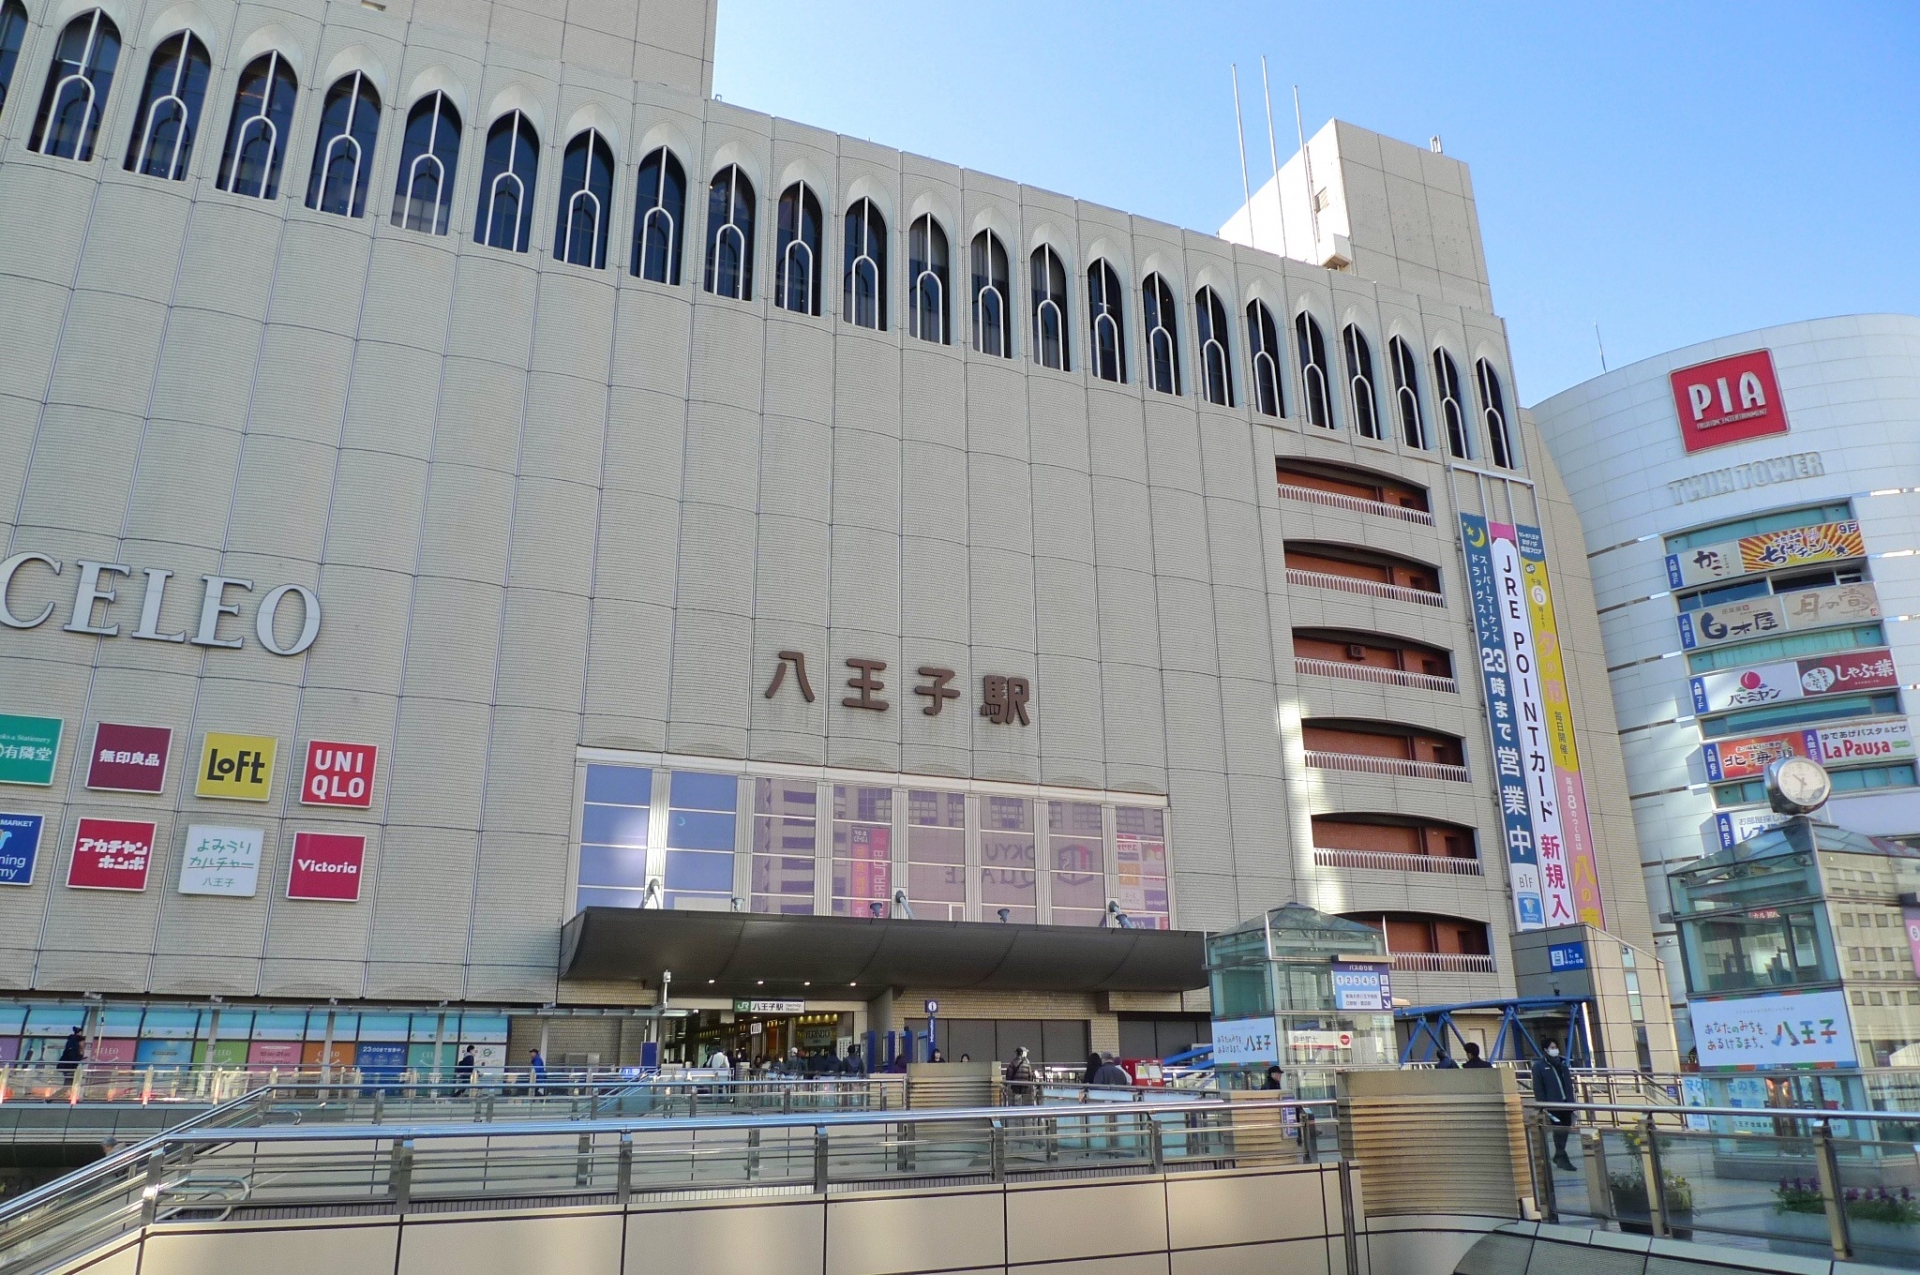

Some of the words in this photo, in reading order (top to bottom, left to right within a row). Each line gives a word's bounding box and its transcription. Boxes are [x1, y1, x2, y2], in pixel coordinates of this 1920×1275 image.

[1687, 370, 1766, 421] PIA
[1667, 467, 1735, 506] TWIN
[1736, 451, 1825, 490] TOWER
[1838, 522, 1858, 535] 9F
[0, 550, 322, 657] CELEO
[1471, 553, 1490, 641] ドラッグストア
[1480, 554, 1500, 643] スーパーマーケット
[1700, 612, 1779, 639] 白木屋
[1835, 659, 1894, 682] しゃぶ葉
[765, 650, 1030, 726] 八王子駅
[1728, 689, 1782, 707] バーミヤン
[1503, 554, 1520, 620] JRE
[1540, 833, 1570, 927] 新規入
[1822, 741, 1842, 759] La
[1843, 738, 1891, 757] Pausa
[4, 744, 53, 762] 有隣堂
[98, 748, 160, 767] 無印良品
[314, 748, 364, 773] UNI
[1481, 647, 1532, 856] 23時まで営業中
[310, 774, 366, 800] QLO
[78, 838, 148, 856] アカチャン
[195, 837, 253, 855] よみうり
[97, 856, 146, 872] ホンポ
[188, 854, 255, 870] カルチャー
[297, 858, 358, 875] Victoria
[201, 876, 235, 888] 八王子
[737, 1001, 750, 1011] JR
[752, 1002, 784, 1011] 八王子駅
[1704, 1020, 1768, 1036] あなたのみちを、
[1771, 1018, 1838, 1047] 八王子
[1244, 1034, 1271, 1052] 八王子
[1707, 1036, 1764, 1051] あるけるまち。
